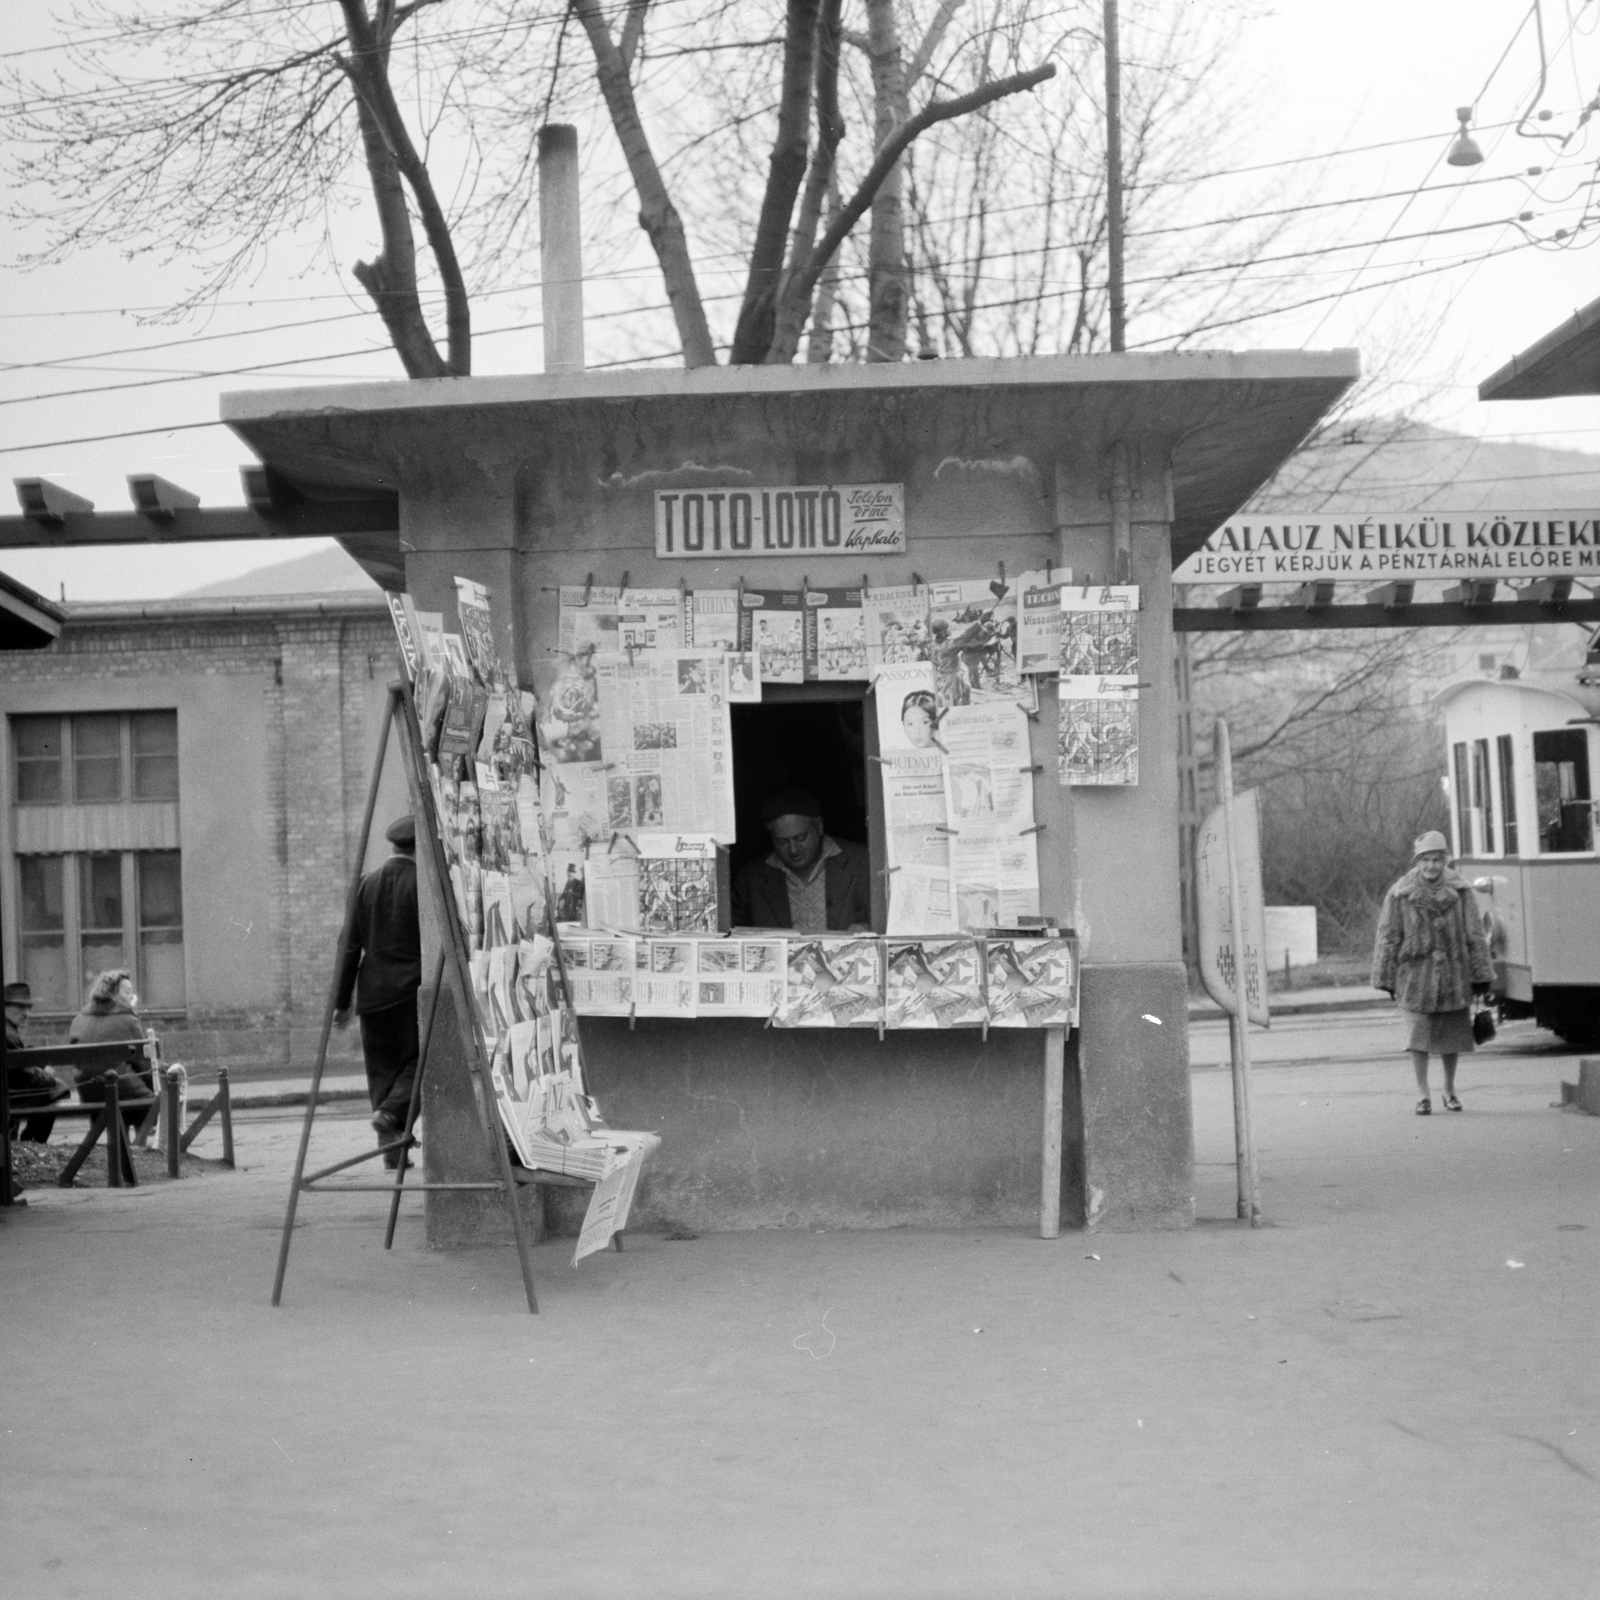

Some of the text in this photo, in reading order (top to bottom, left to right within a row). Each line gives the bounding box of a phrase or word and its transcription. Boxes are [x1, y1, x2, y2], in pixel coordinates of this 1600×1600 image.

[846, 490, 893, 505] Telefon
[659, 491, 841, 552] TOTO-LOTTO
[1334, 516, 1456, 549] NÉLKÜL
[845, 527, 901, 550] Kapható
[1194, 551, 1266, 573] JEGYÉT
[1276, 551, 1353, 571] KÉRJÜK
[1360, 554, 1373, 570] A
[1379, 547, 1502, 570] PÉNZTÁRNÁL
[1508, 547, 1572, 567] ELŐRE
